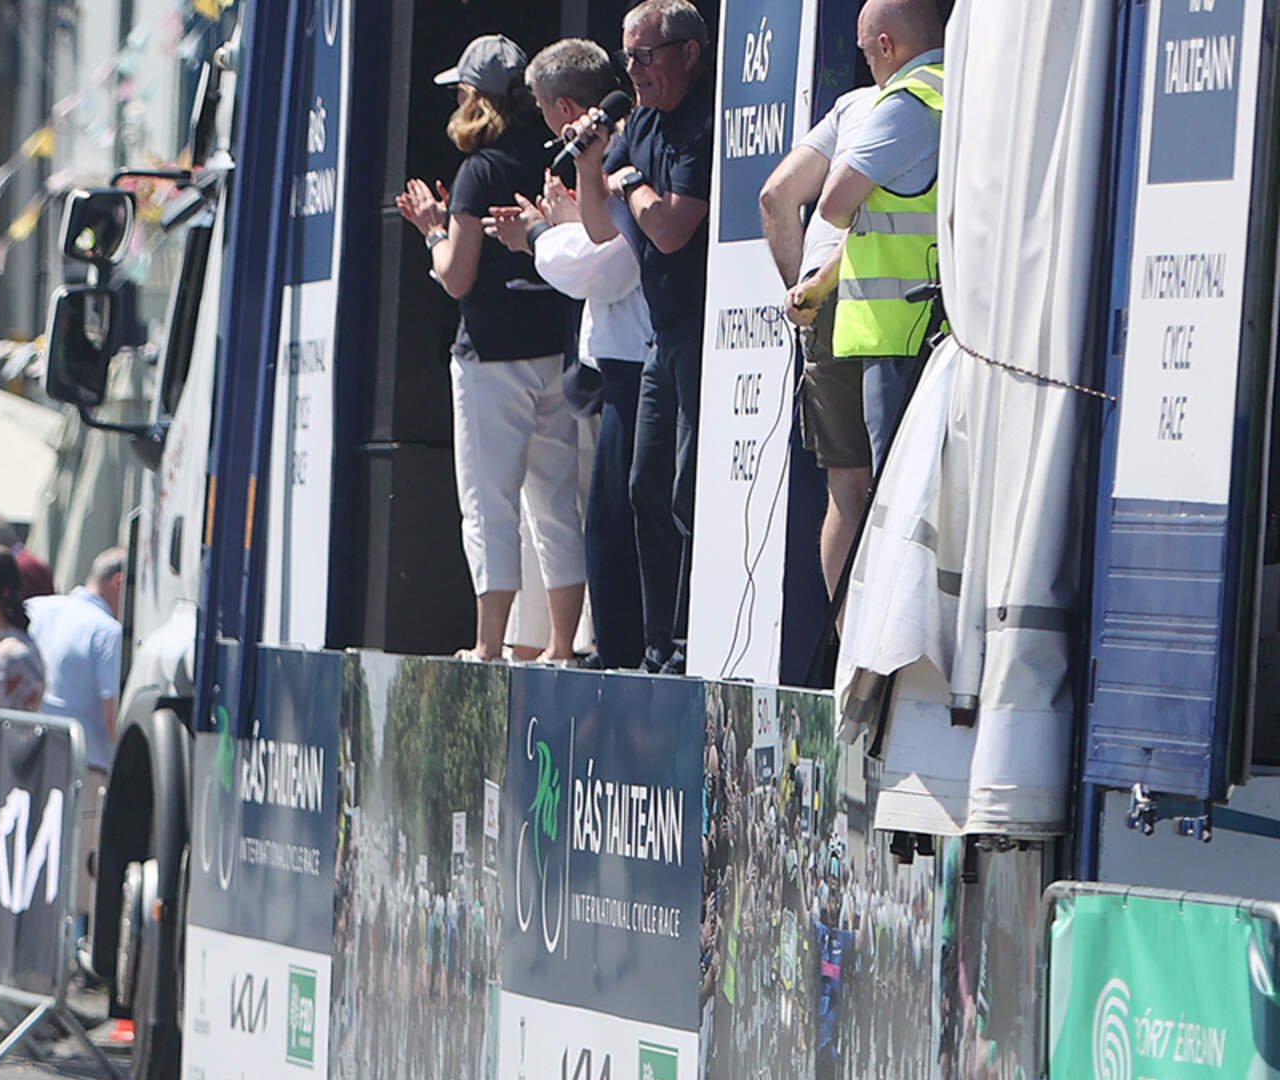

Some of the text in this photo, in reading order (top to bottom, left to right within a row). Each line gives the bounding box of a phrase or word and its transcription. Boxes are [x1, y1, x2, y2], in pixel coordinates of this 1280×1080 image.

[742, 16, 772, 82] RÁS
[1165, 35, 1235, 94] TAILTEANN
[725, 103, 786, 159] TAILTEANN
[1142, 253, 1227, 299] INTERNATIONAL
[1163, 325, 1195, 370] CYCLE
[734, 373, 761, 415] CYCLE
[1158, 396, 1187, 440] RACE
[730, 439, 756, 481] RACE
[267, 739, 324, 813] TAILTEANN
[573, 758, 683, 866] RÁS TAILTEANN
[572, 893, 680, 938] INTERNATIONAL CYCLE RACE
